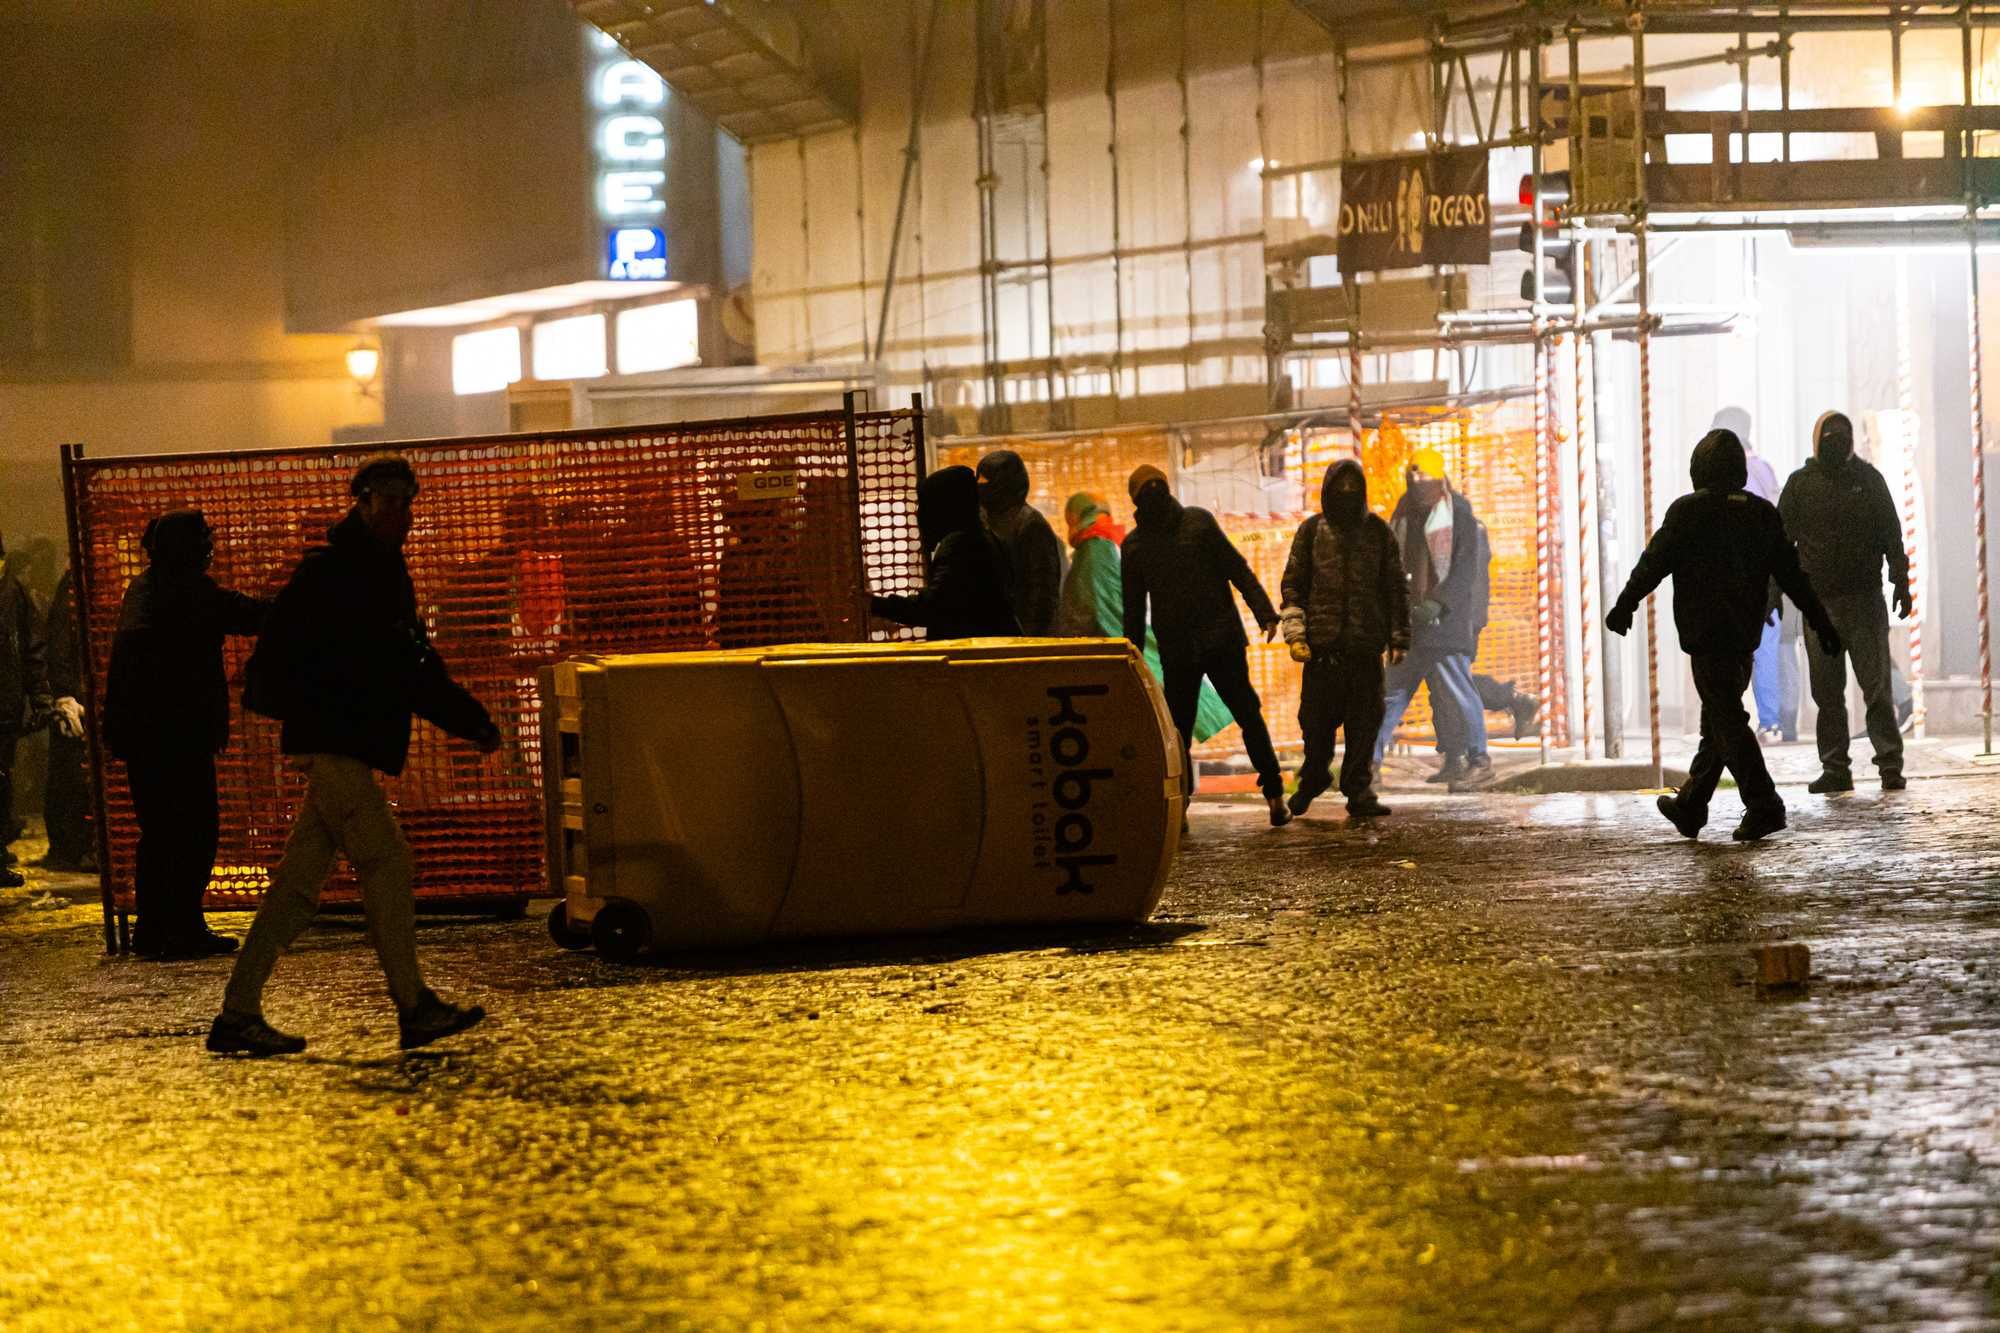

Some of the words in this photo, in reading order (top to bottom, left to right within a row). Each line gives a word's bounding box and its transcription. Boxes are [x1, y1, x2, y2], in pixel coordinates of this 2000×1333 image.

[600, 30, 667, 215] AGE
[1025, 715, 1048, 789] smart
[1046, 683, 1118, 896] kobak
[1031, 801, 1051, 869] toilet
